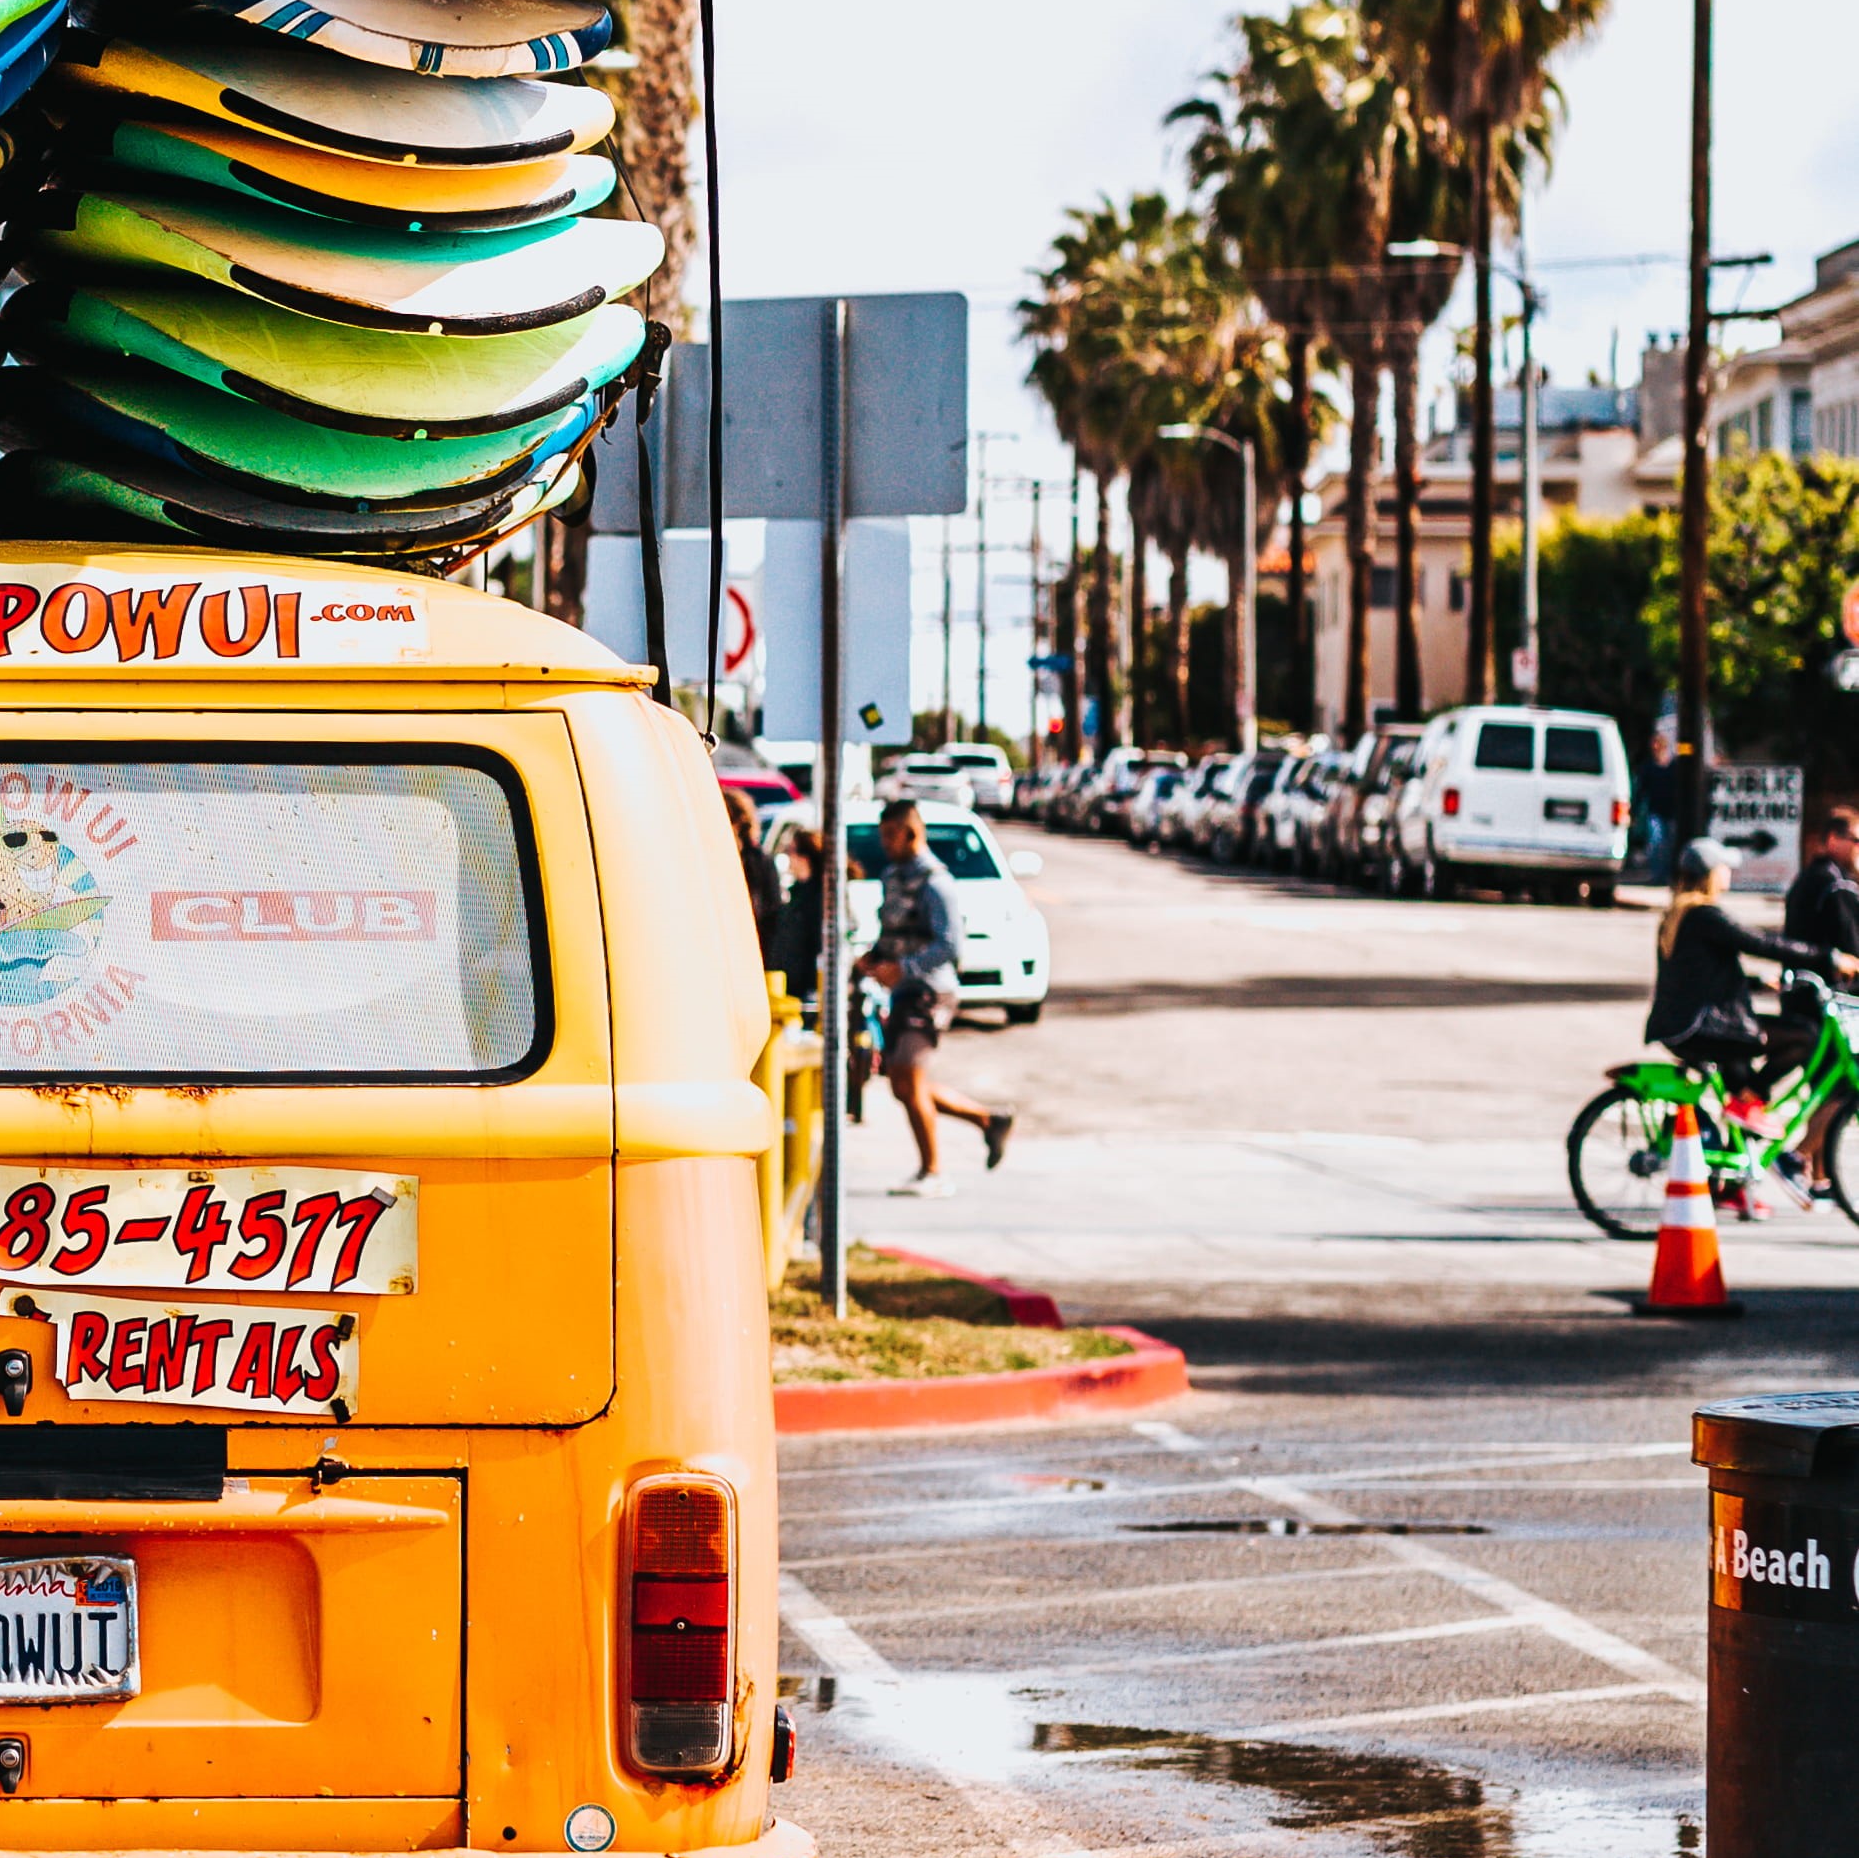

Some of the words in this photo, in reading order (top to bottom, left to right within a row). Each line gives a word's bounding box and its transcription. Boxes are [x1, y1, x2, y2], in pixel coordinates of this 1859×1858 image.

[170, 896, 423, 934] CLUB
[65, 1308, 345, 1403] RENTALS
[1733, 1528, 1831, 1590] Beach
